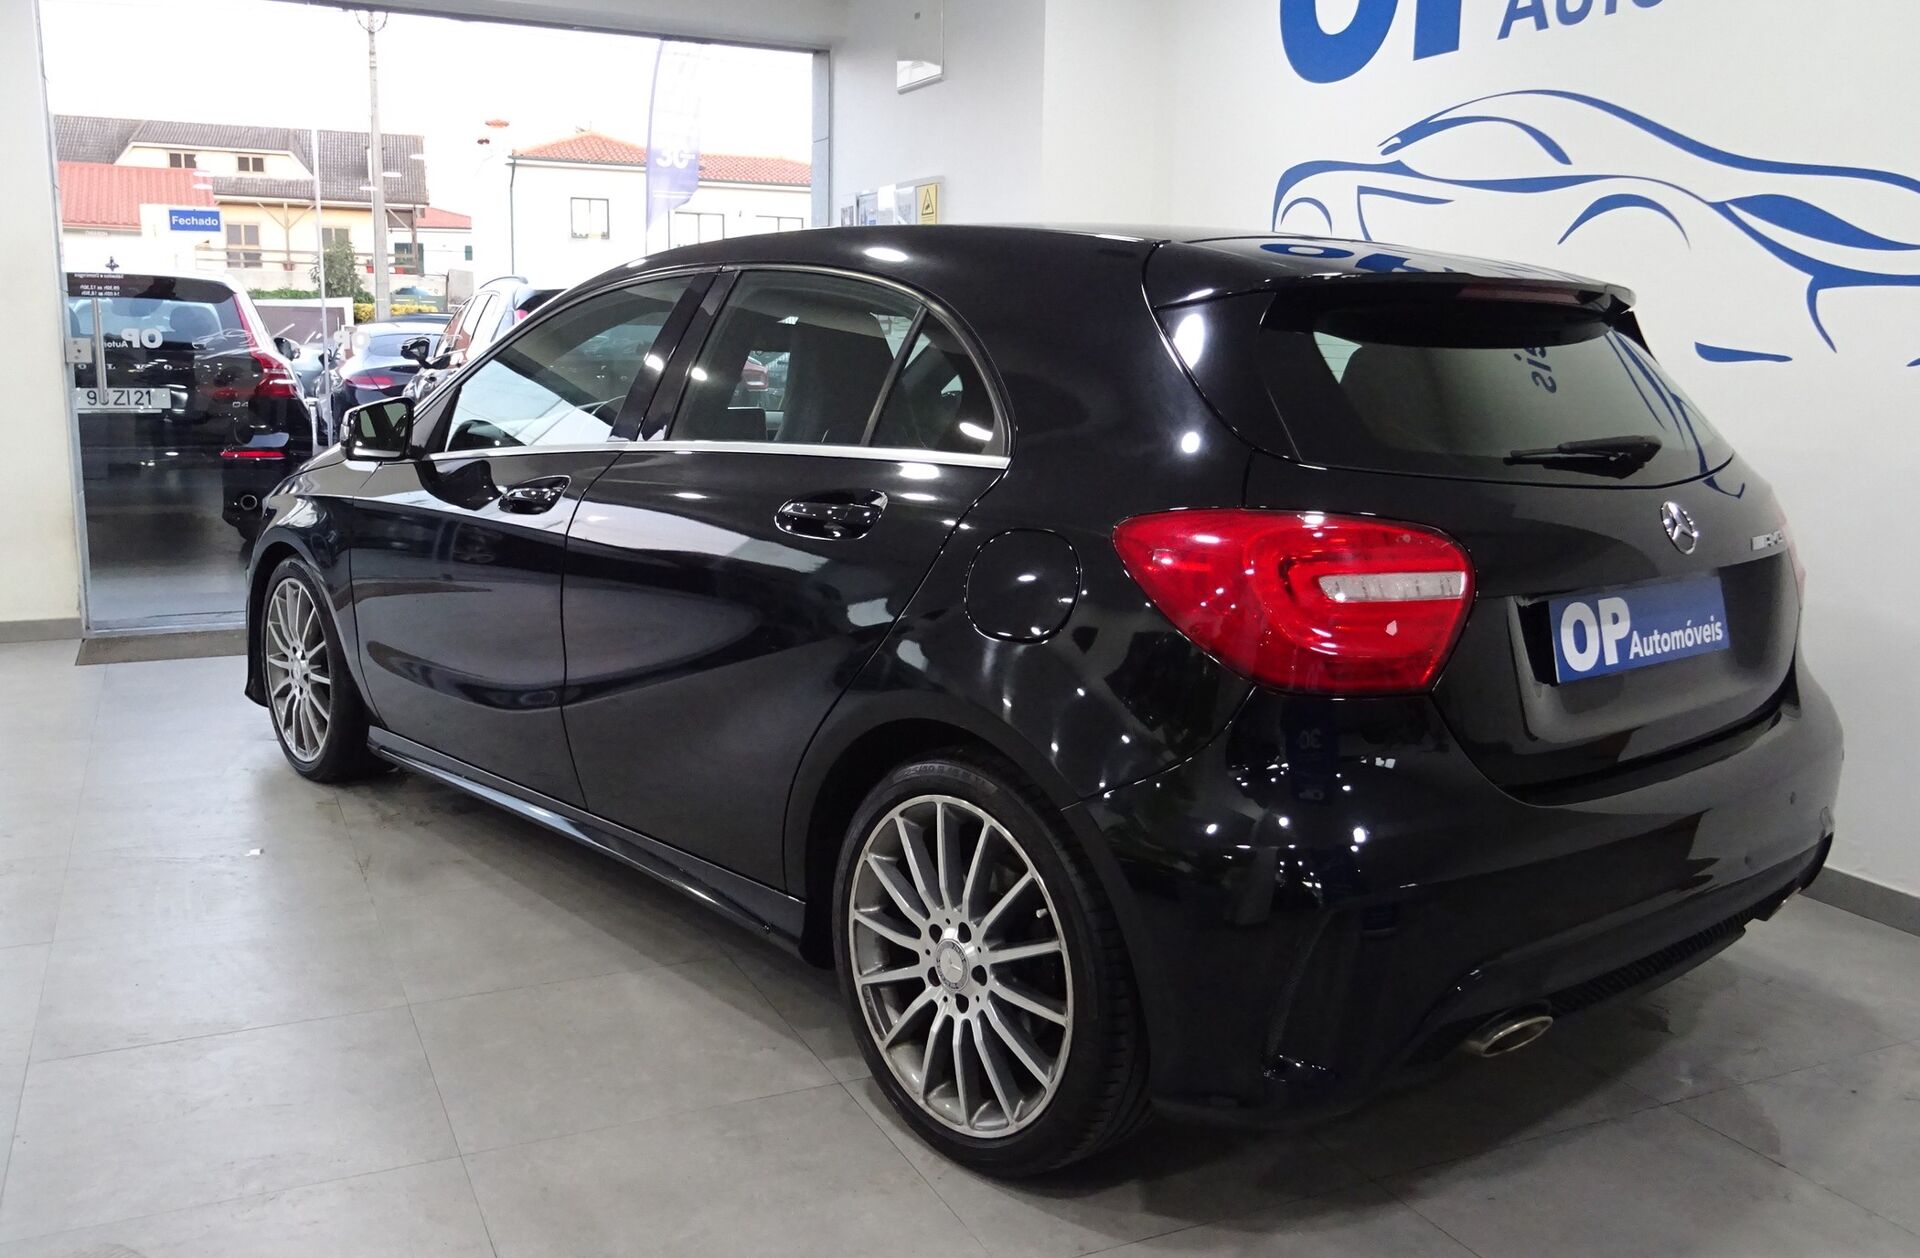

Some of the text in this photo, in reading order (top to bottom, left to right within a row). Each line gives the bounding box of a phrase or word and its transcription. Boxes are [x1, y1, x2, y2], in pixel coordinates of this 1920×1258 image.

[171, 215, 219, 227] Fechado
[1560, 596, 1723, 672] OP Automóveis
